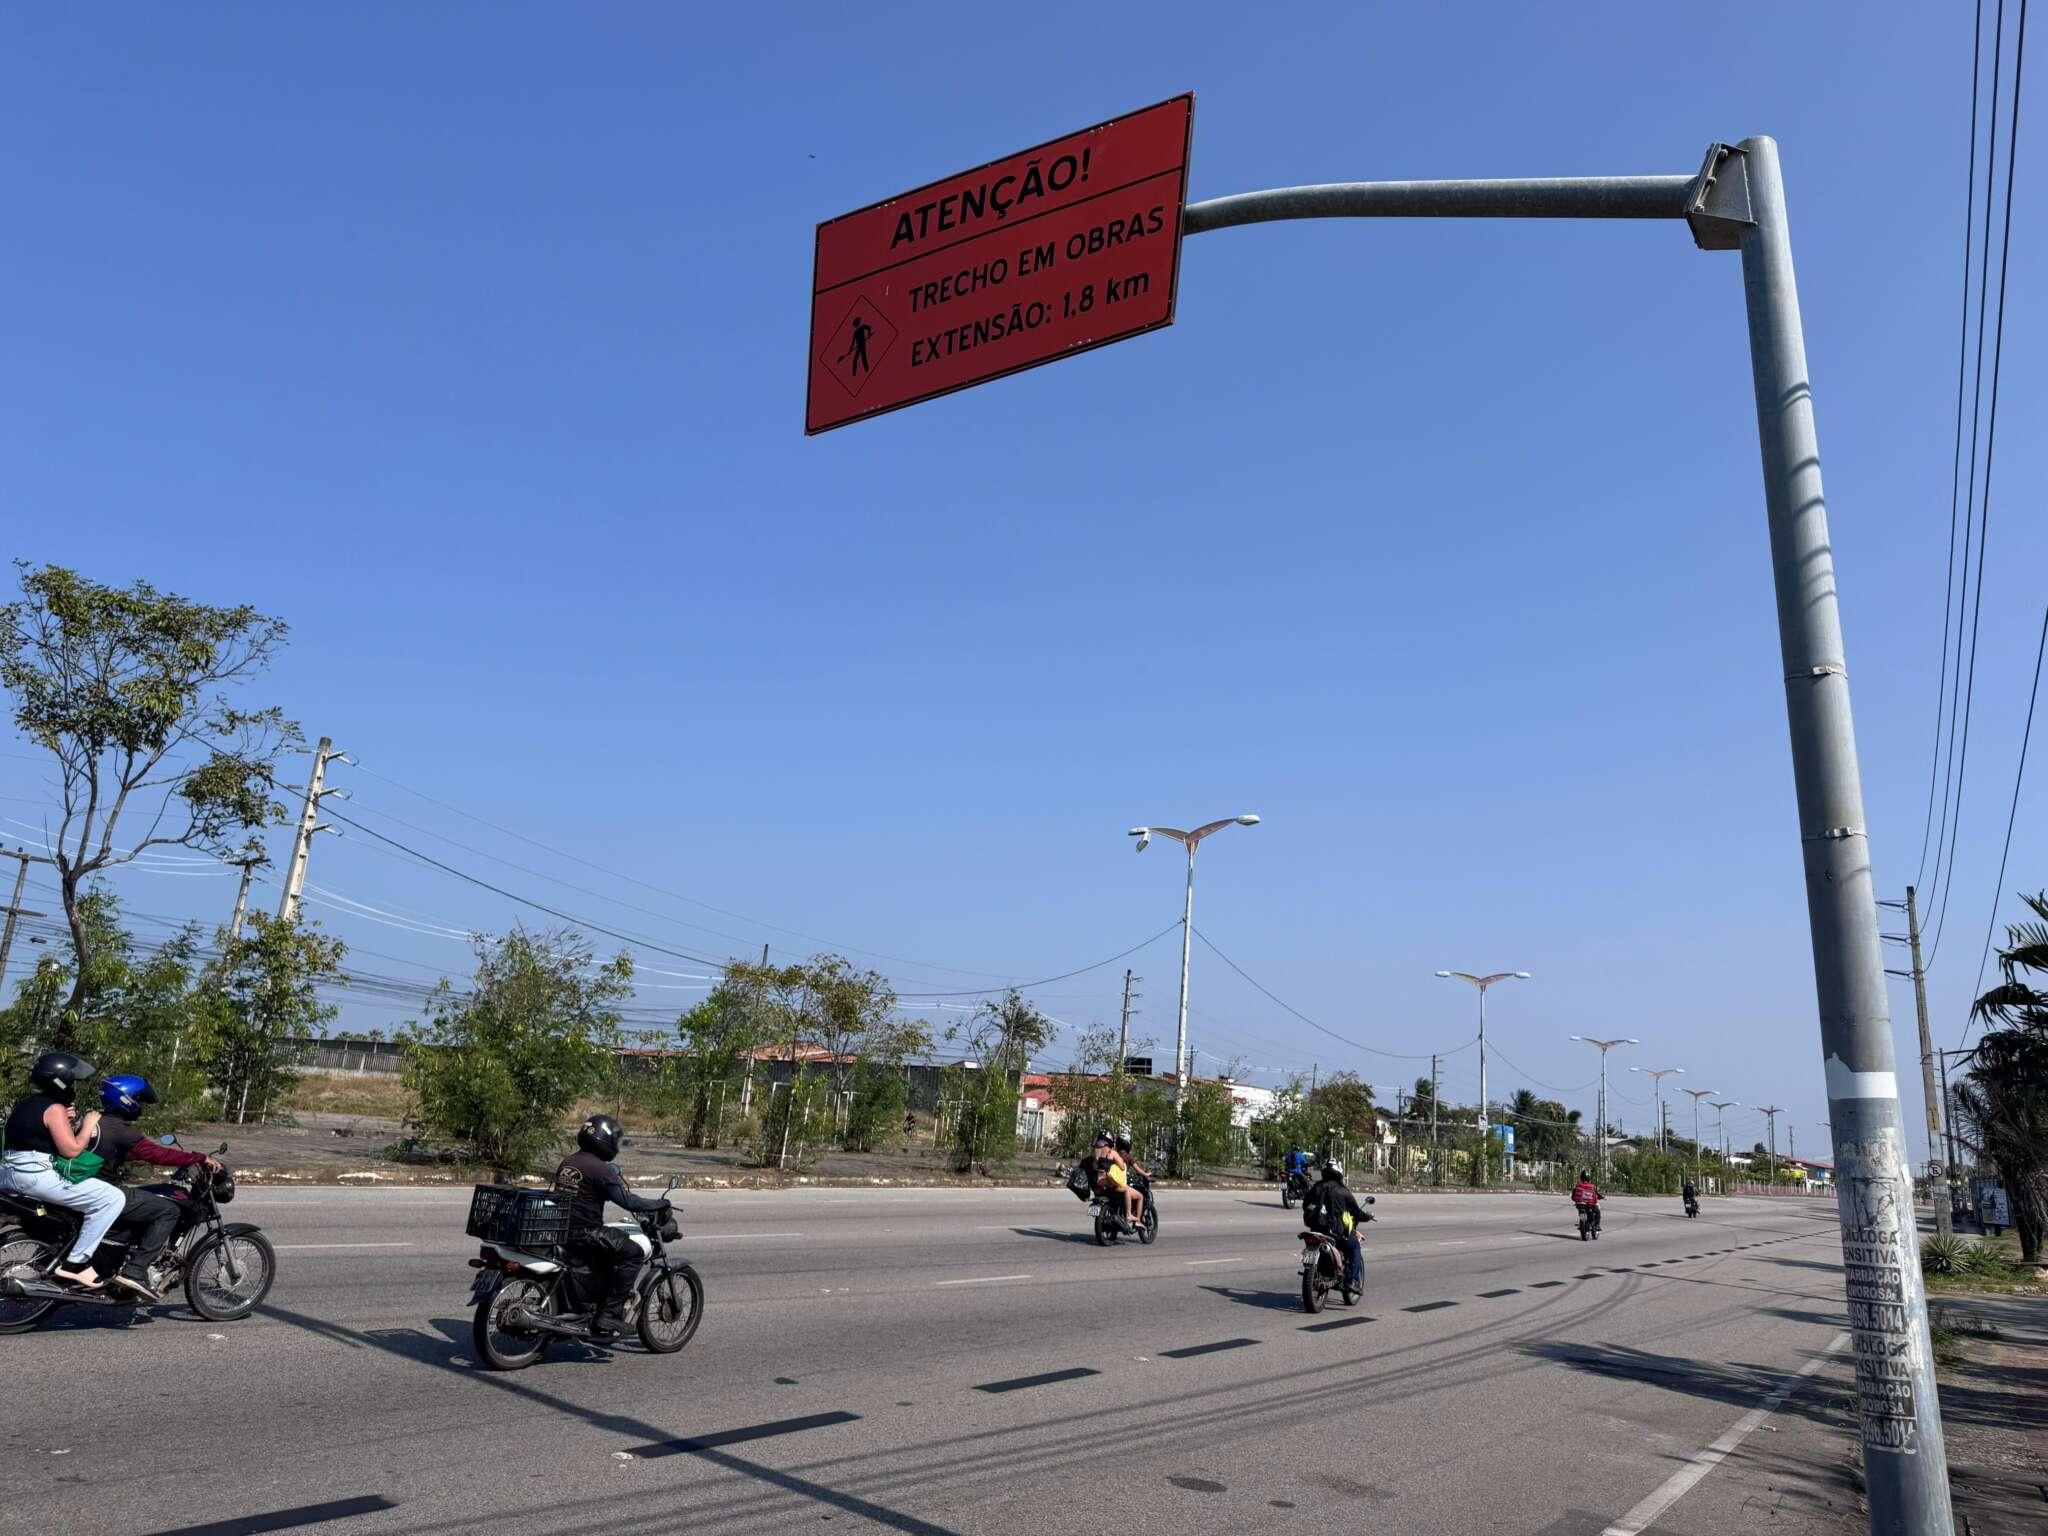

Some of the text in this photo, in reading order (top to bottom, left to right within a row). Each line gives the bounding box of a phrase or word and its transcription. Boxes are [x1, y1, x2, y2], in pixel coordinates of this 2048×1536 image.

[889, 147, 1091, 250] ATENÇÃO!
[908, 206, 1165, 313] TRECHO EM OBRAS
[911, 301, 1054, 368] EXTENSÃO:
[1105, 272, 1150, 305] km
